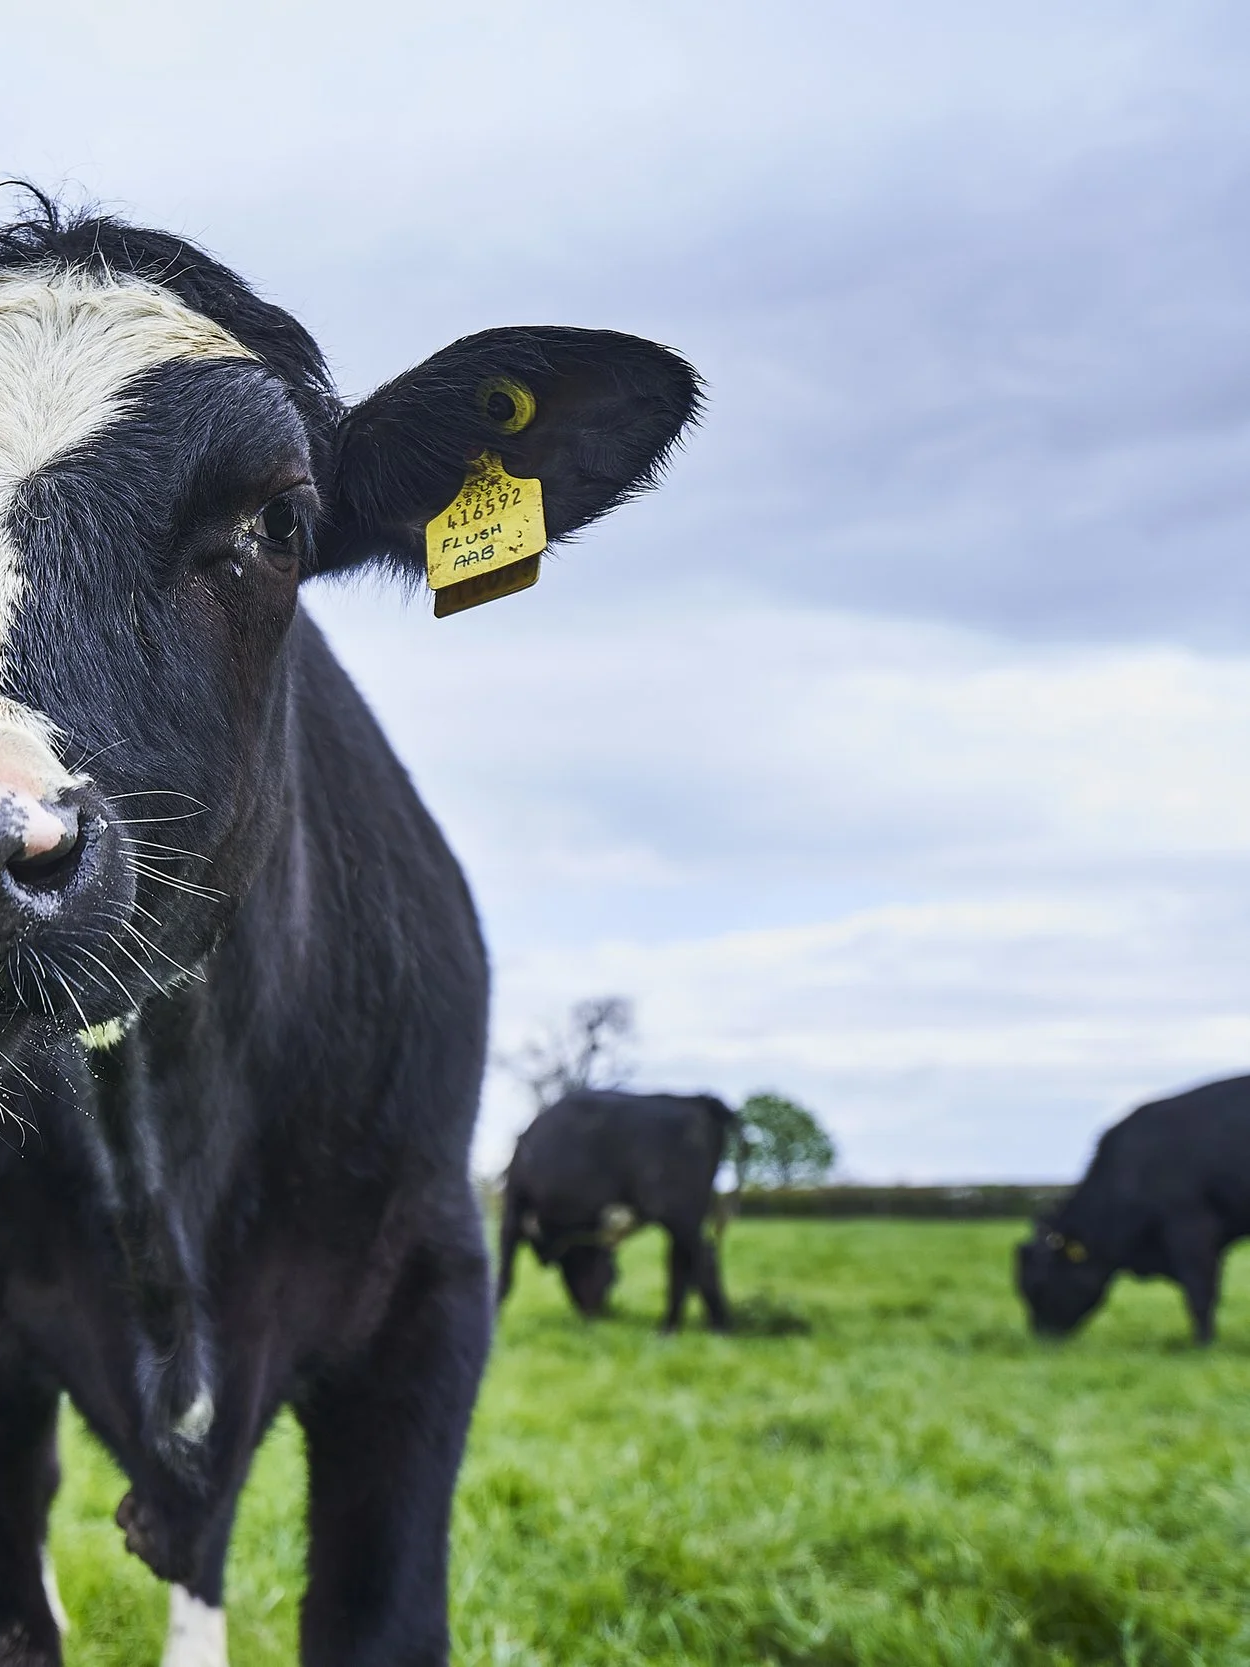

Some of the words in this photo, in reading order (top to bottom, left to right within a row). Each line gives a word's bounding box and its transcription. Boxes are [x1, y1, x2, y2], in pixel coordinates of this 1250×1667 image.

[447, 487, 522, 530] 416592
[455, 481, 512, 510] 582935
[441, 523, 502, 553] FLUSH
[453, 544, 495, 571] AAB
